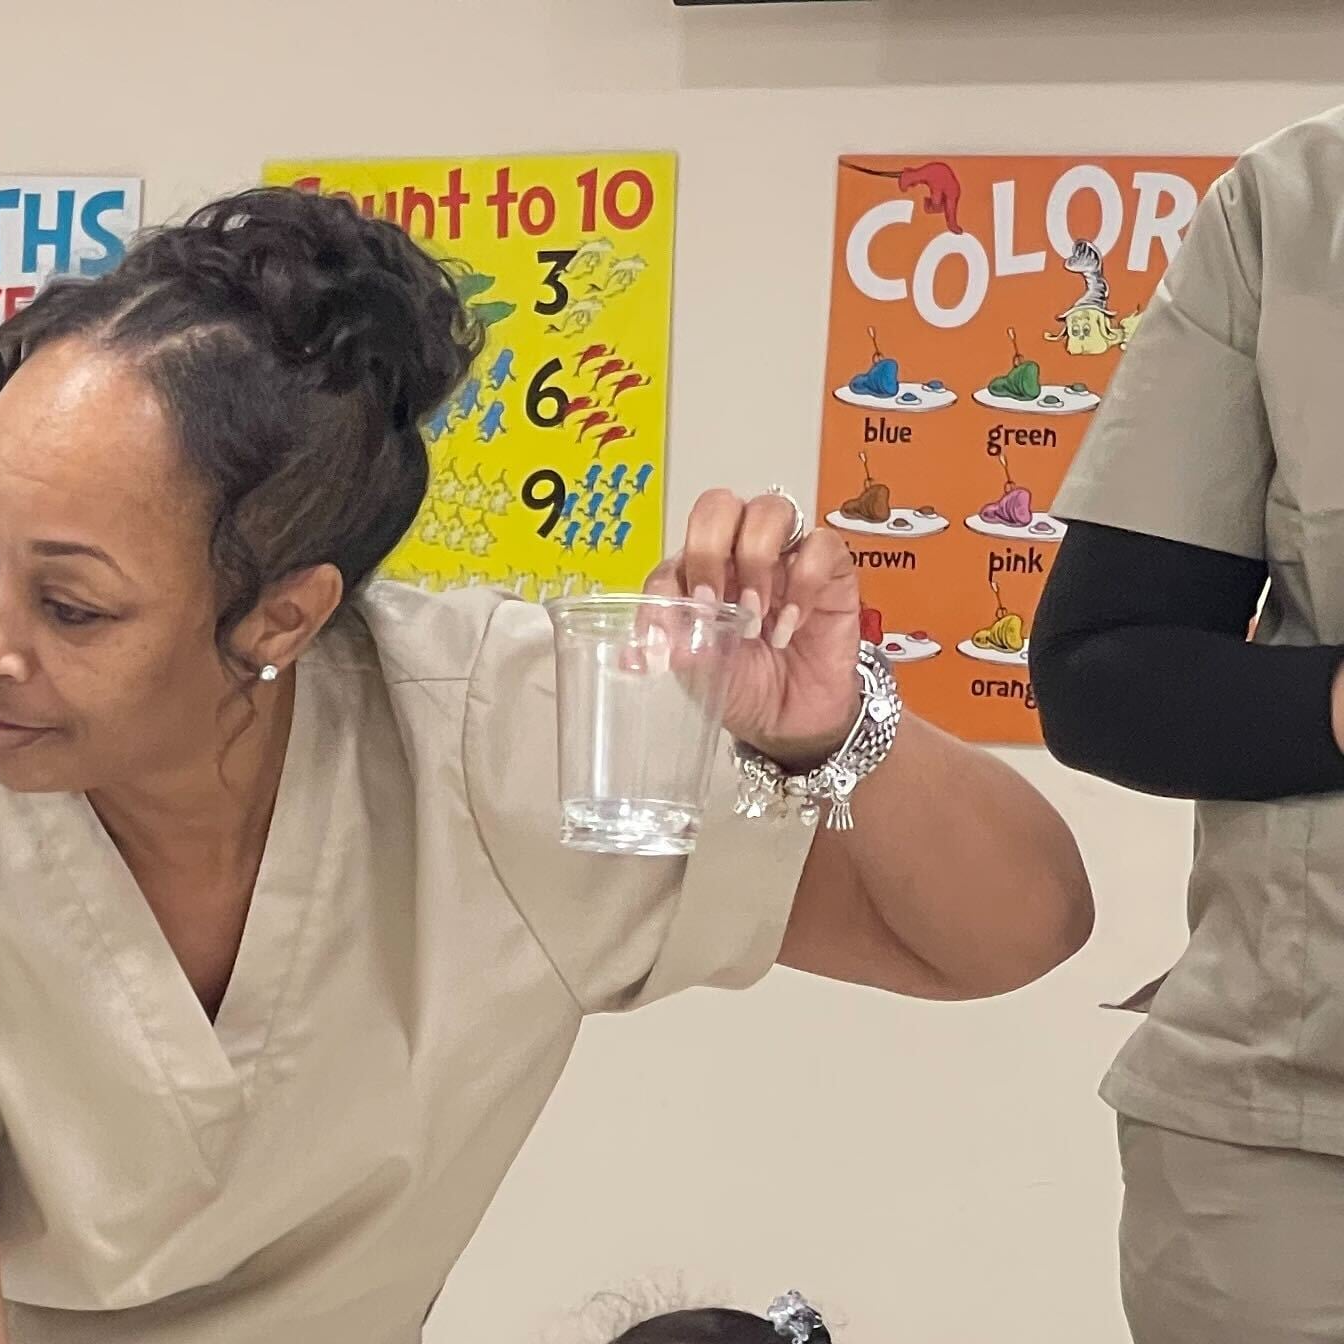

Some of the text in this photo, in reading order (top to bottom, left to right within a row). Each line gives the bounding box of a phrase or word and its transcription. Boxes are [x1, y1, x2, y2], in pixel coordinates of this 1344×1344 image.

[487, 166, 556, 240] to
[577, 166, 654, 232] 10
[845, 164, 1201, 329] COLOR
[534, 250, 579, 316] 3
[525, 357, 569, 429] 6
[863, 417, 912, 444] blue
[986, 424, 1057, 456] green
[521, 469, 566, 539] 9
[989, 547, 1044, 583] pink
[971, 678, 1037, 709] orang
